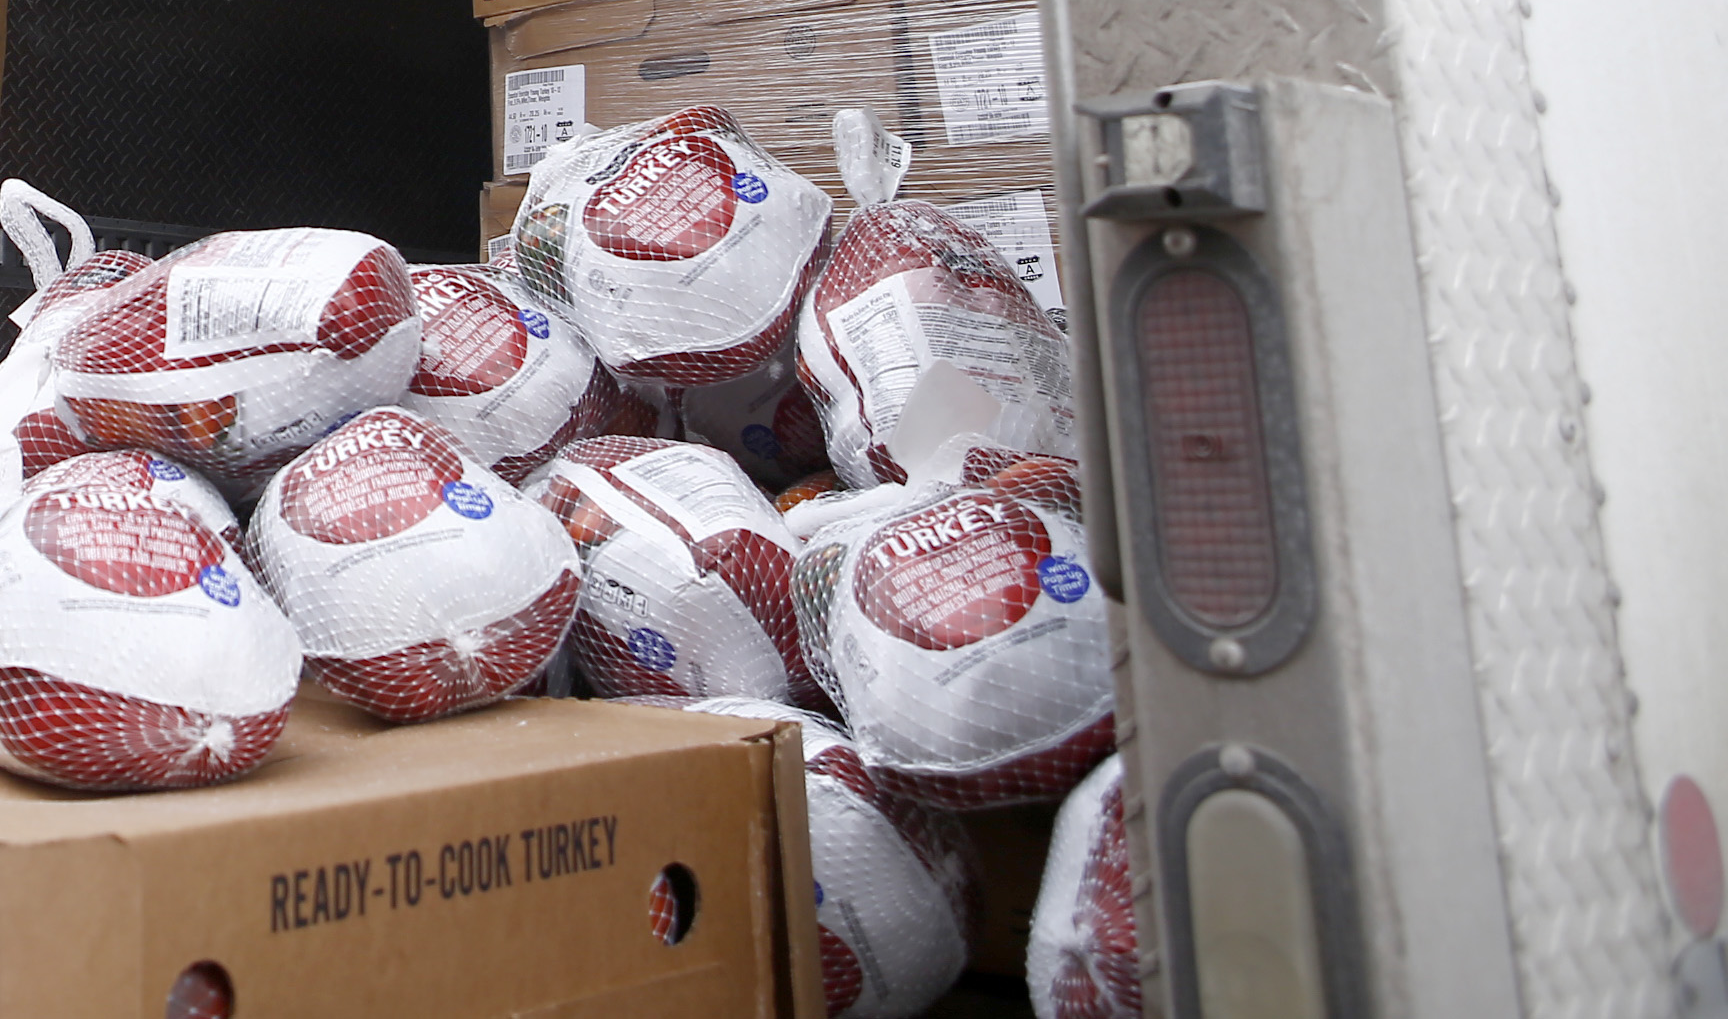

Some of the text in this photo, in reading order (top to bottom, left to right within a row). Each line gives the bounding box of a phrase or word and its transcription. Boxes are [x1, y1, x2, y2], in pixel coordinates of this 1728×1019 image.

[561, 126, 567, 136] A
[891, 145, 902, 169] 11.19
[595, 140, 696, 215] TURKEY
[415, 273, 444, 293] NG
[1025, 264, 1035, 275] A
[295, 429, 425, 479] TURKEY
[50, 492, 190, 519] TURKEY
[885, 499, 978, 534] YOUNG
[868, 503, 1005, 565] TURKEY
[972, 530, 1007, 551] TURKEY
[926, 578, 968, 605] NATURAL
[962, 558, 1010, 584] FLAVORING
[1007, 552, 1027, 568] FOR
[915, 568, 1025, 629] TENDERNESS AND JUICINESS
[271, 815, 618, 932] READY-TO-COOK TURKEY
